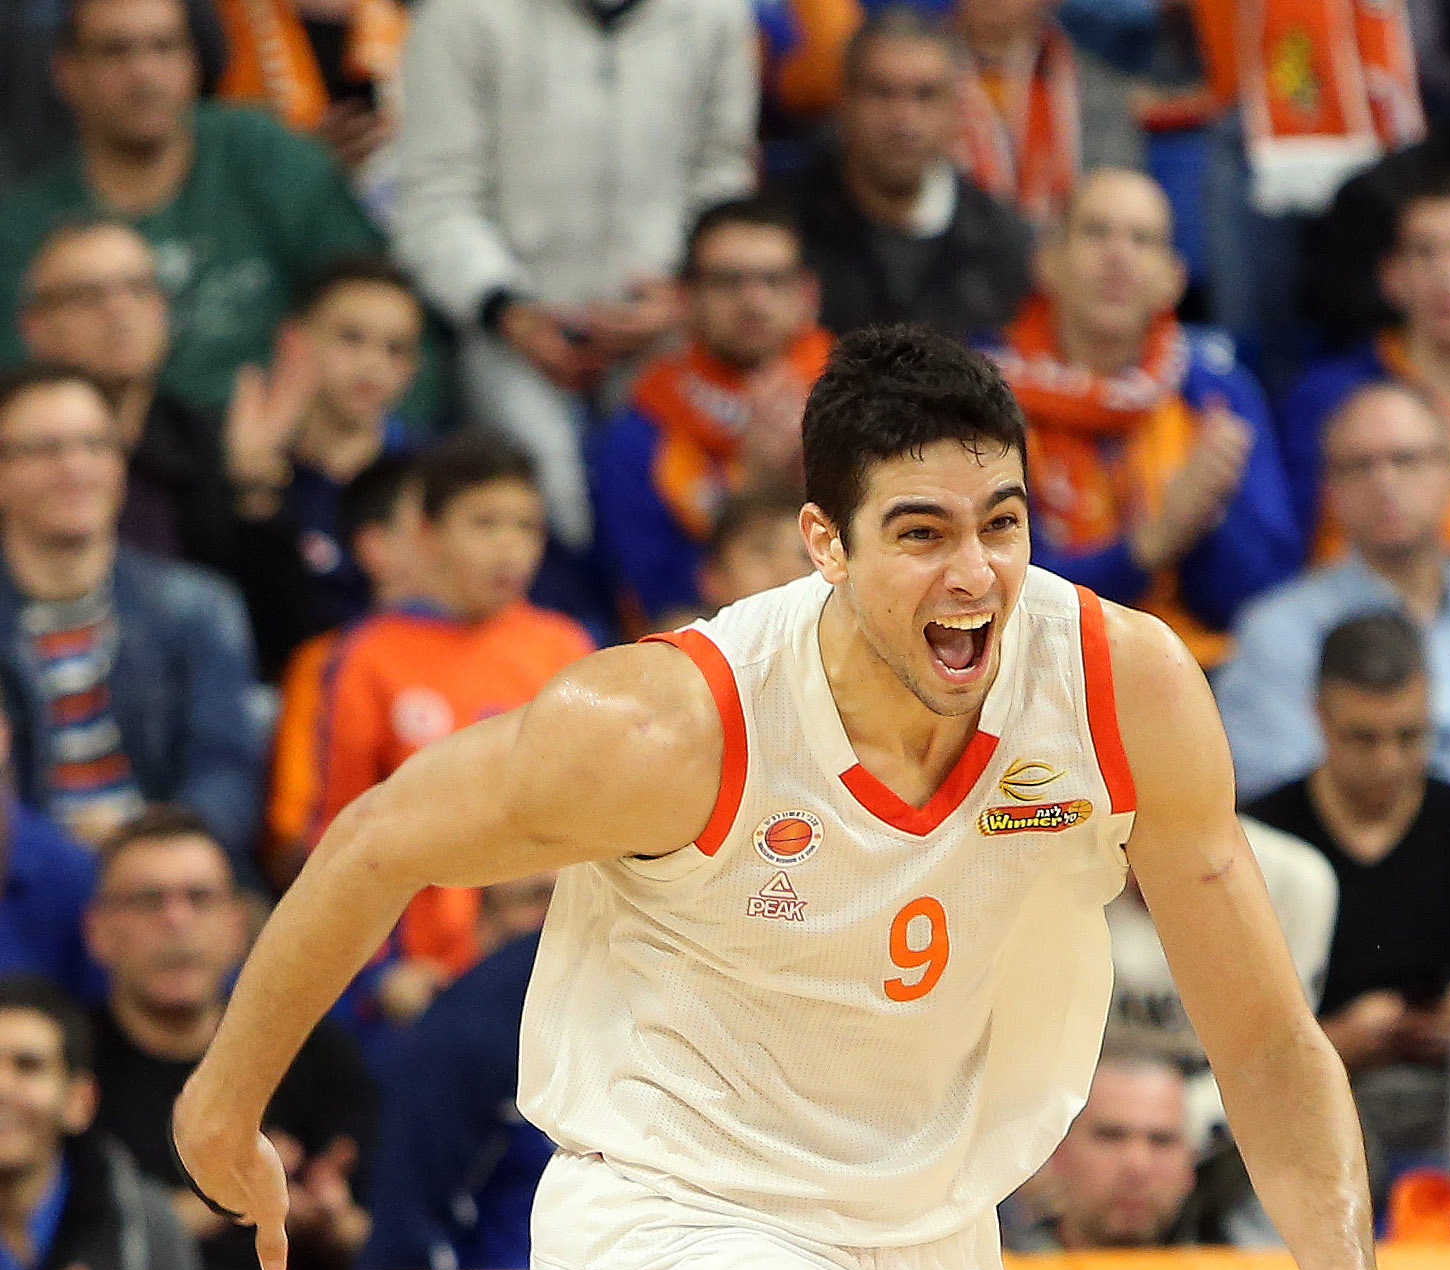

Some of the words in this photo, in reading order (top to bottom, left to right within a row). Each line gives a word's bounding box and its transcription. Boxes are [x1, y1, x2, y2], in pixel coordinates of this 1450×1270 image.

[988, 813, 1063, 831] Winner
[747, 897, 808, 921] PEAK
[884, 896, 950, 1003] 9
